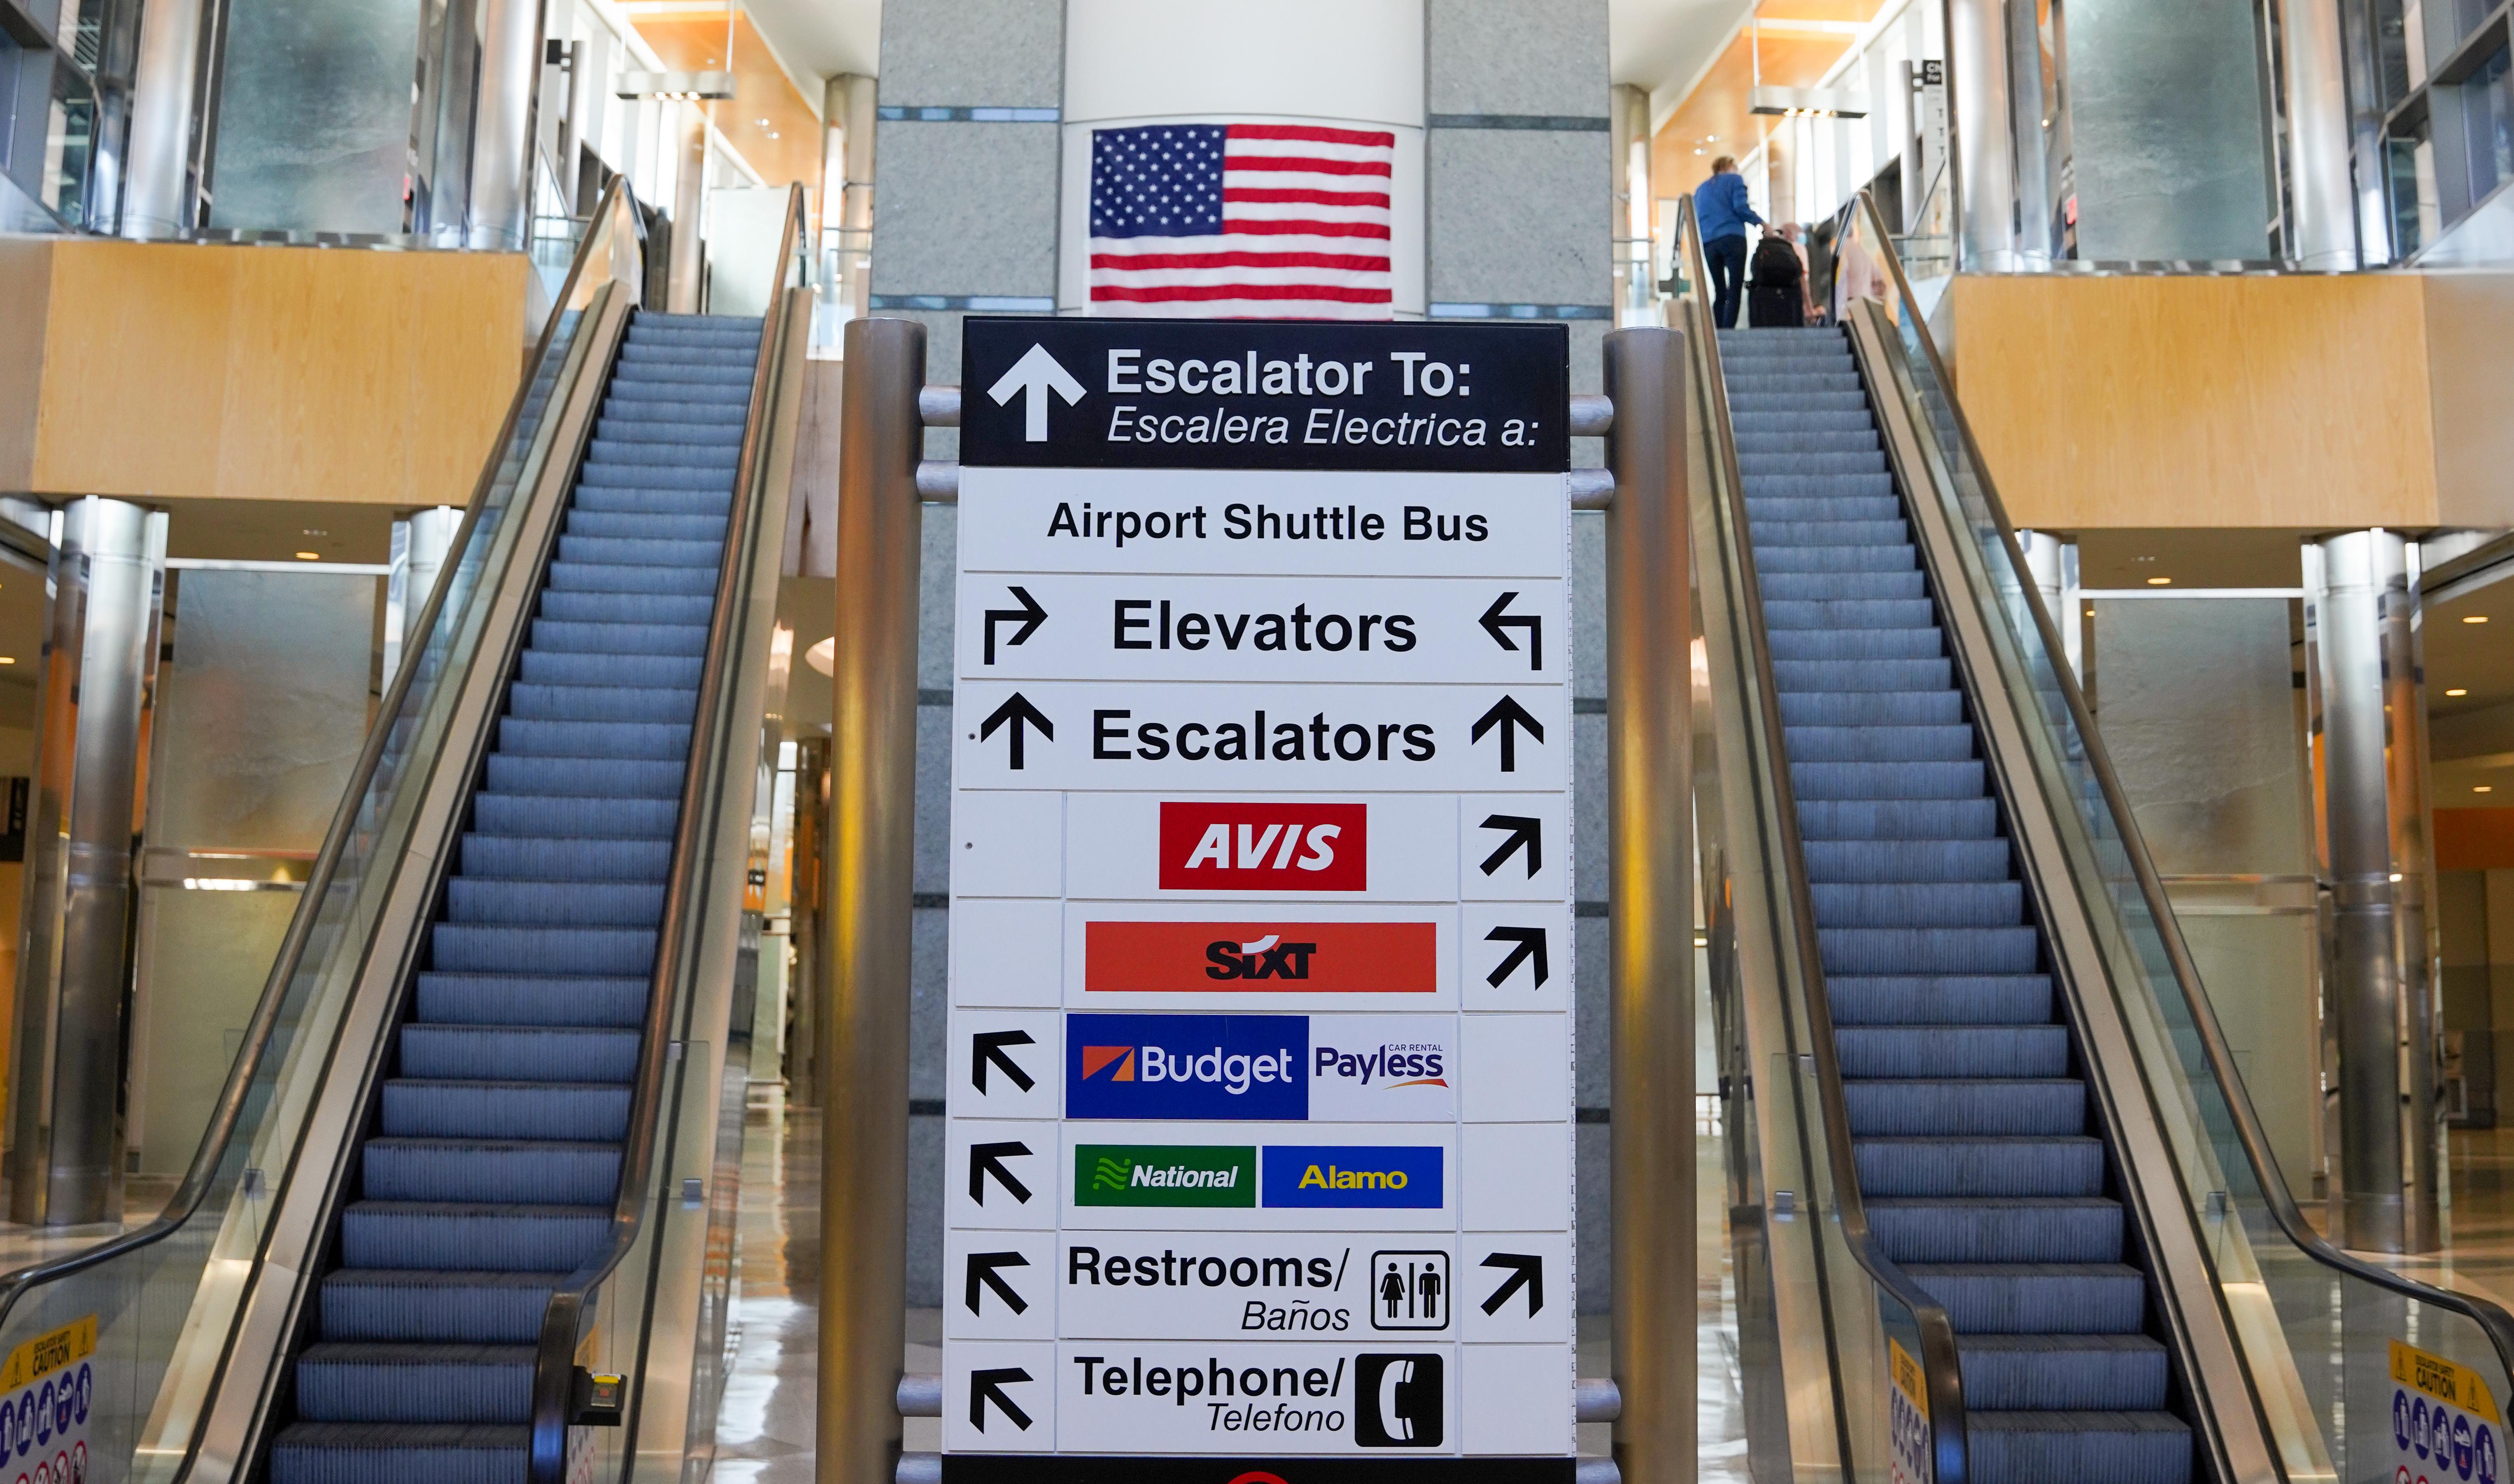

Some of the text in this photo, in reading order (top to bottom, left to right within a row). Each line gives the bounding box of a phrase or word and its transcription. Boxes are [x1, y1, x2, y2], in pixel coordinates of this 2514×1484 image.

[1108, 349, 1470, 396] Escalator To:
[1108, 406, 1539, 446] Escalera Electrica a:
[1047, 502, 1489, 548] Airport Shuttle Bus
[1114, 599, 1417, 652] Elevators
[1093, 709, 1436, 762] Escalators
[1184, 823, 1342, 871] AVIS
[1142, 1046, 1293, 1095] Budget
[1315, 1044, 1444, 1085] Payless
[1130, 1165, 1238, 1188] National
[1298, 1165, 1408, 1190] Alamo
[1069, 1246, 1350, 1292] Restrooms/
[1241, 1300, 1350, 1331] Baños
[33, 1343, 70, 1376] CAUTION
[1074, 1356, 1345, 1406] Telephone/
[2416, 1367, 2456, 1402] CAUTION
[1207, 1403, 1345, 1432] Telefono
